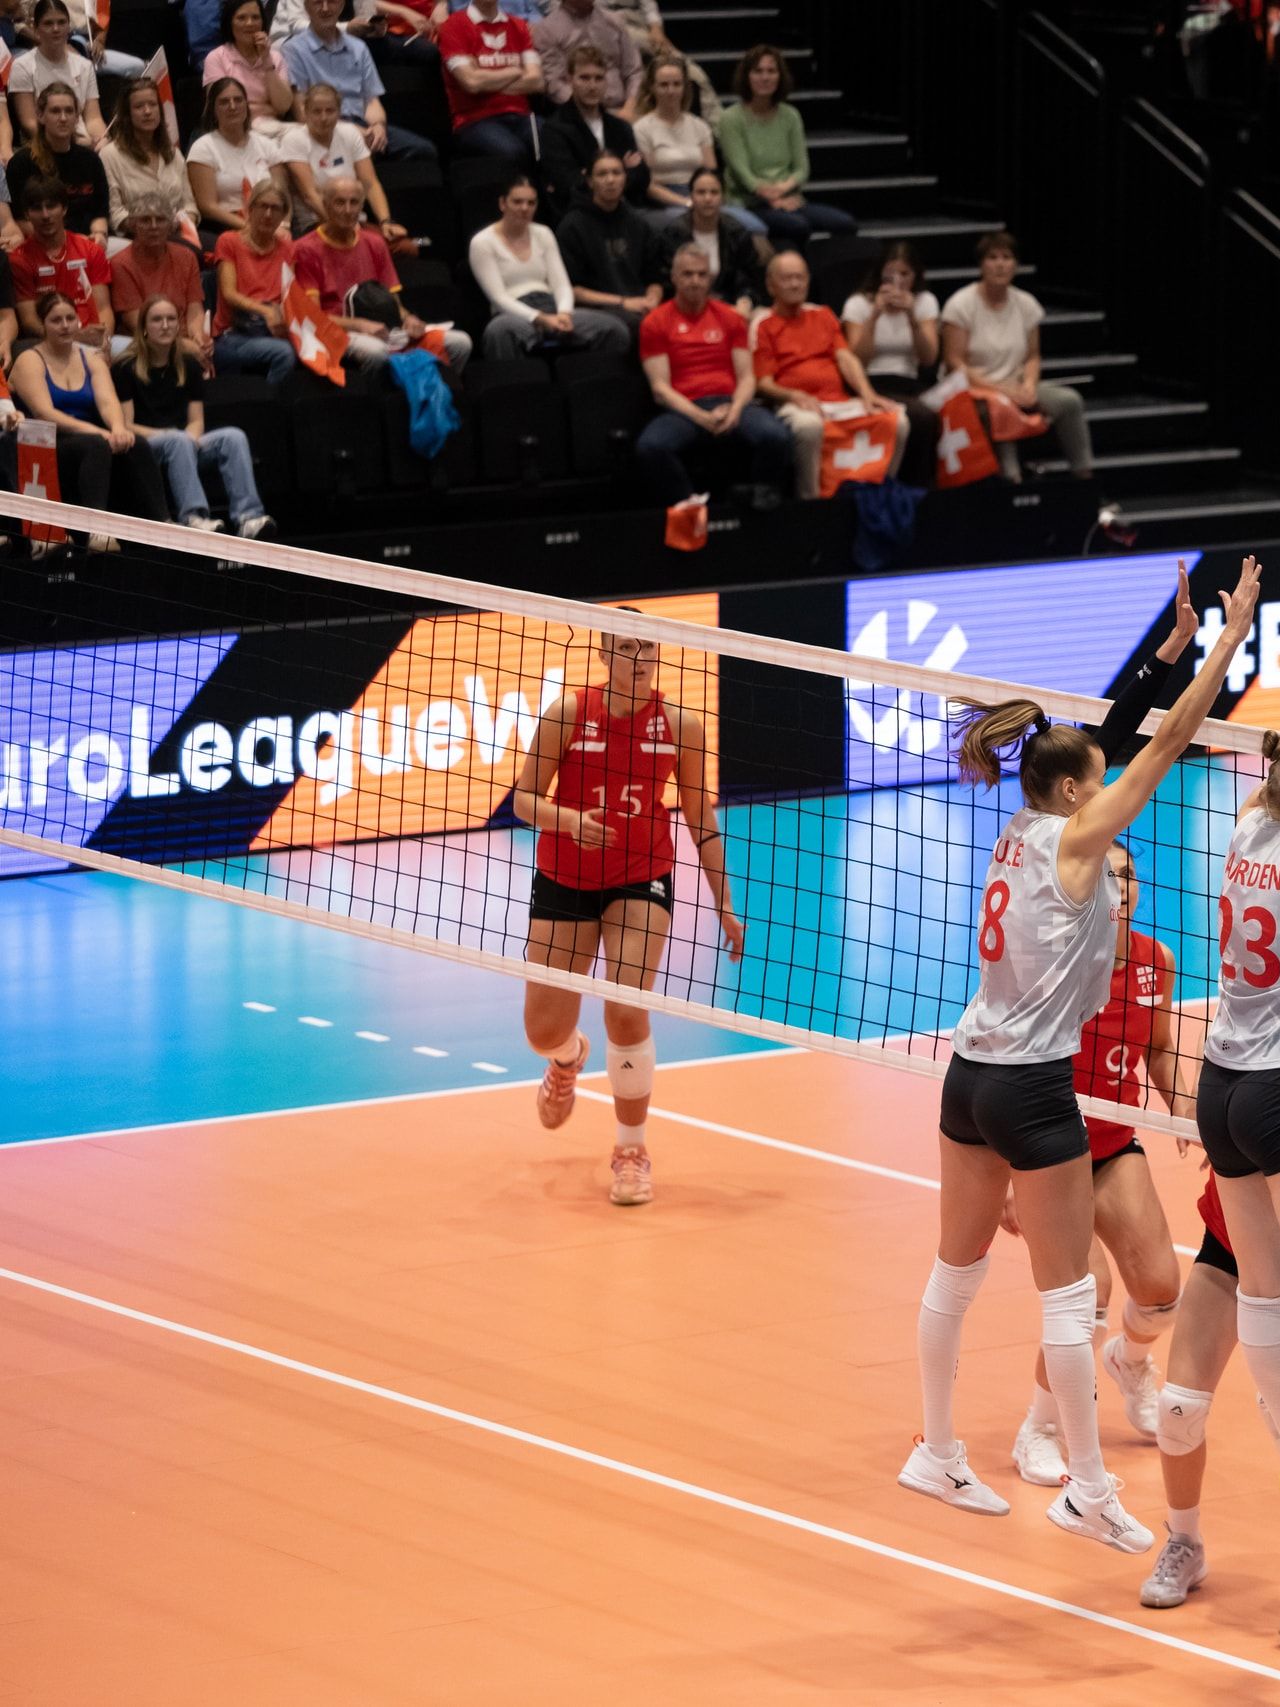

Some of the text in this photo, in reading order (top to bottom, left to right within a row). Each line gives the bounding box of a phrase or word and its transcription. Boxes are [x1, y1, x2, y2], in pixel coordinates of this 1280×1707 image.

[591, 784, 643, 818] 15
[978, 879, 1010, 963] 8
[1105, 1044, 1129, 1086] 9
